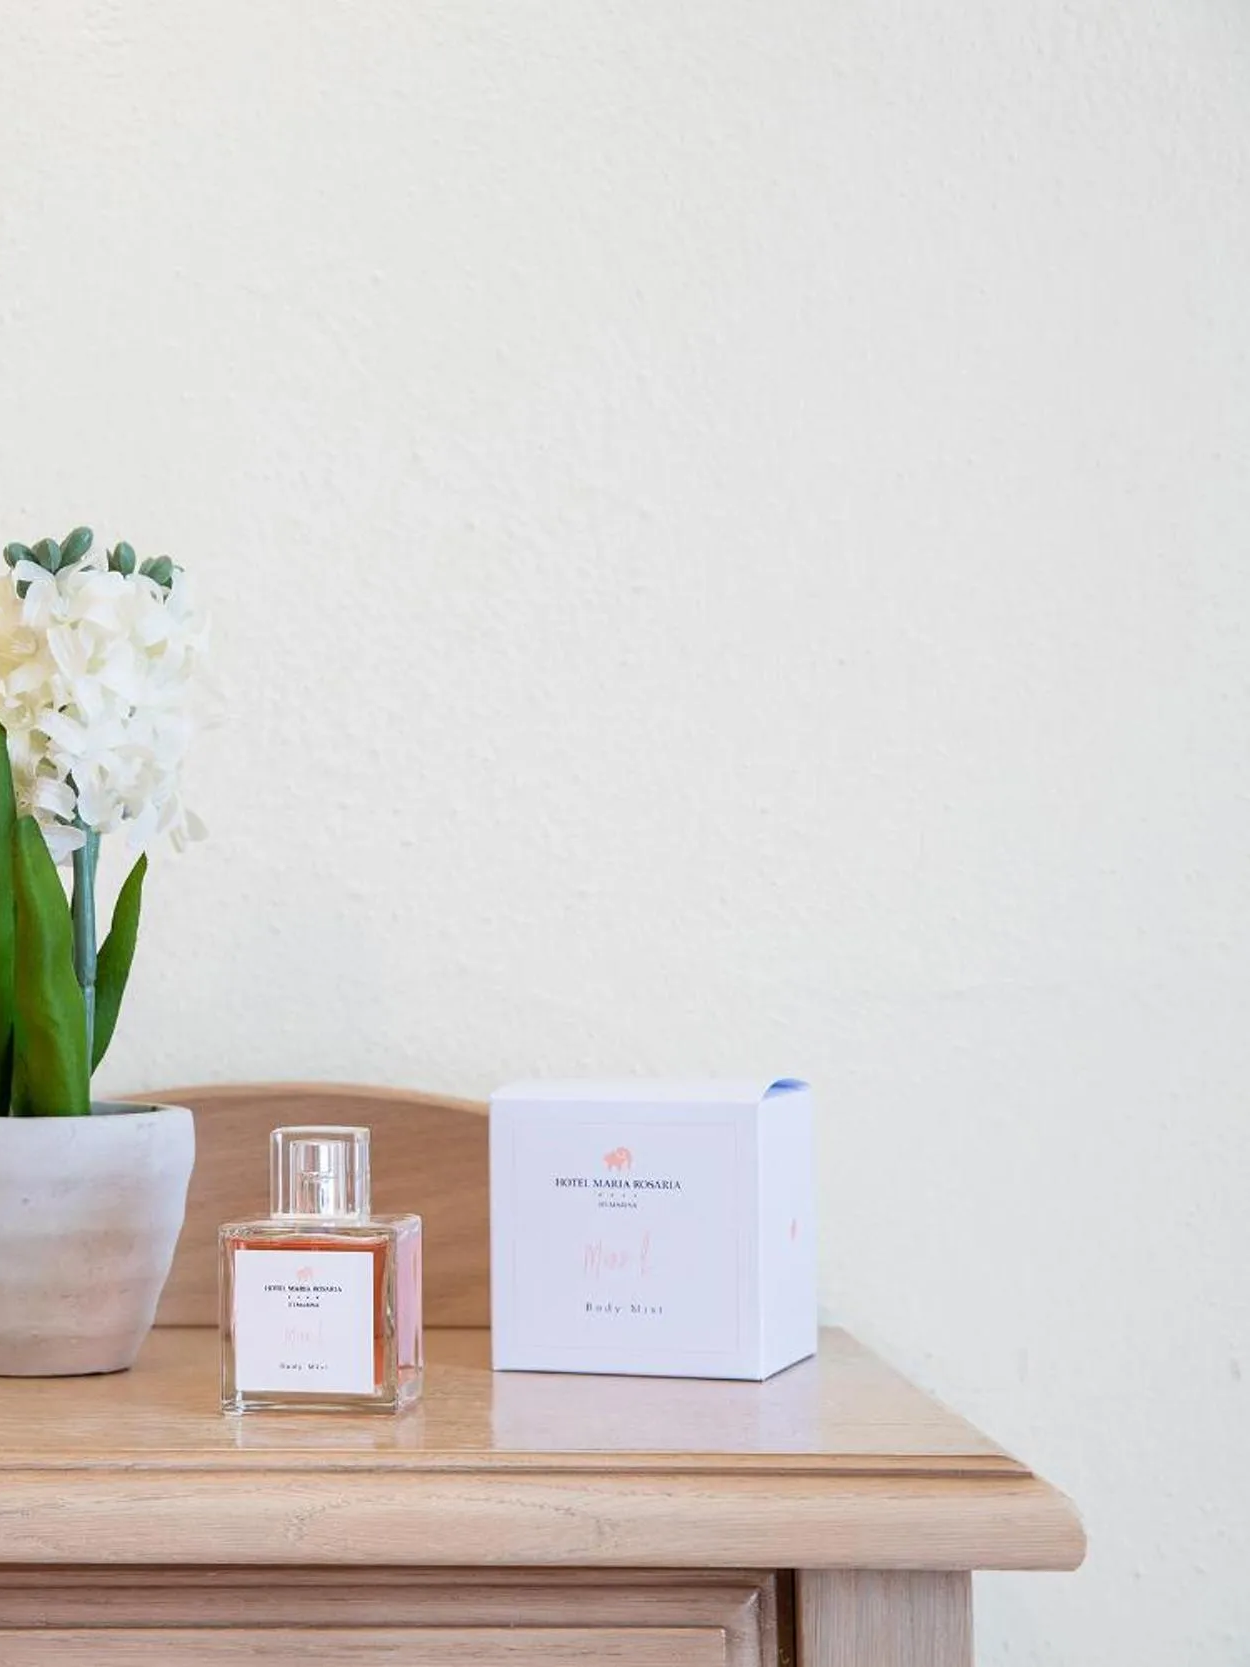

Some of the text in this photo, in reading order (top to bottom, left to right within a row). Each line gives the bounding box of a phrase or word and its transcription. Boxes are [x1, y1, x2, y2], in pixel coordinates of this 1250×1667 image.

[555, 1177, 682, 1190] HOTEL MARIA ROSARIA
[585, 1301, 663, 1315] Body Mist
